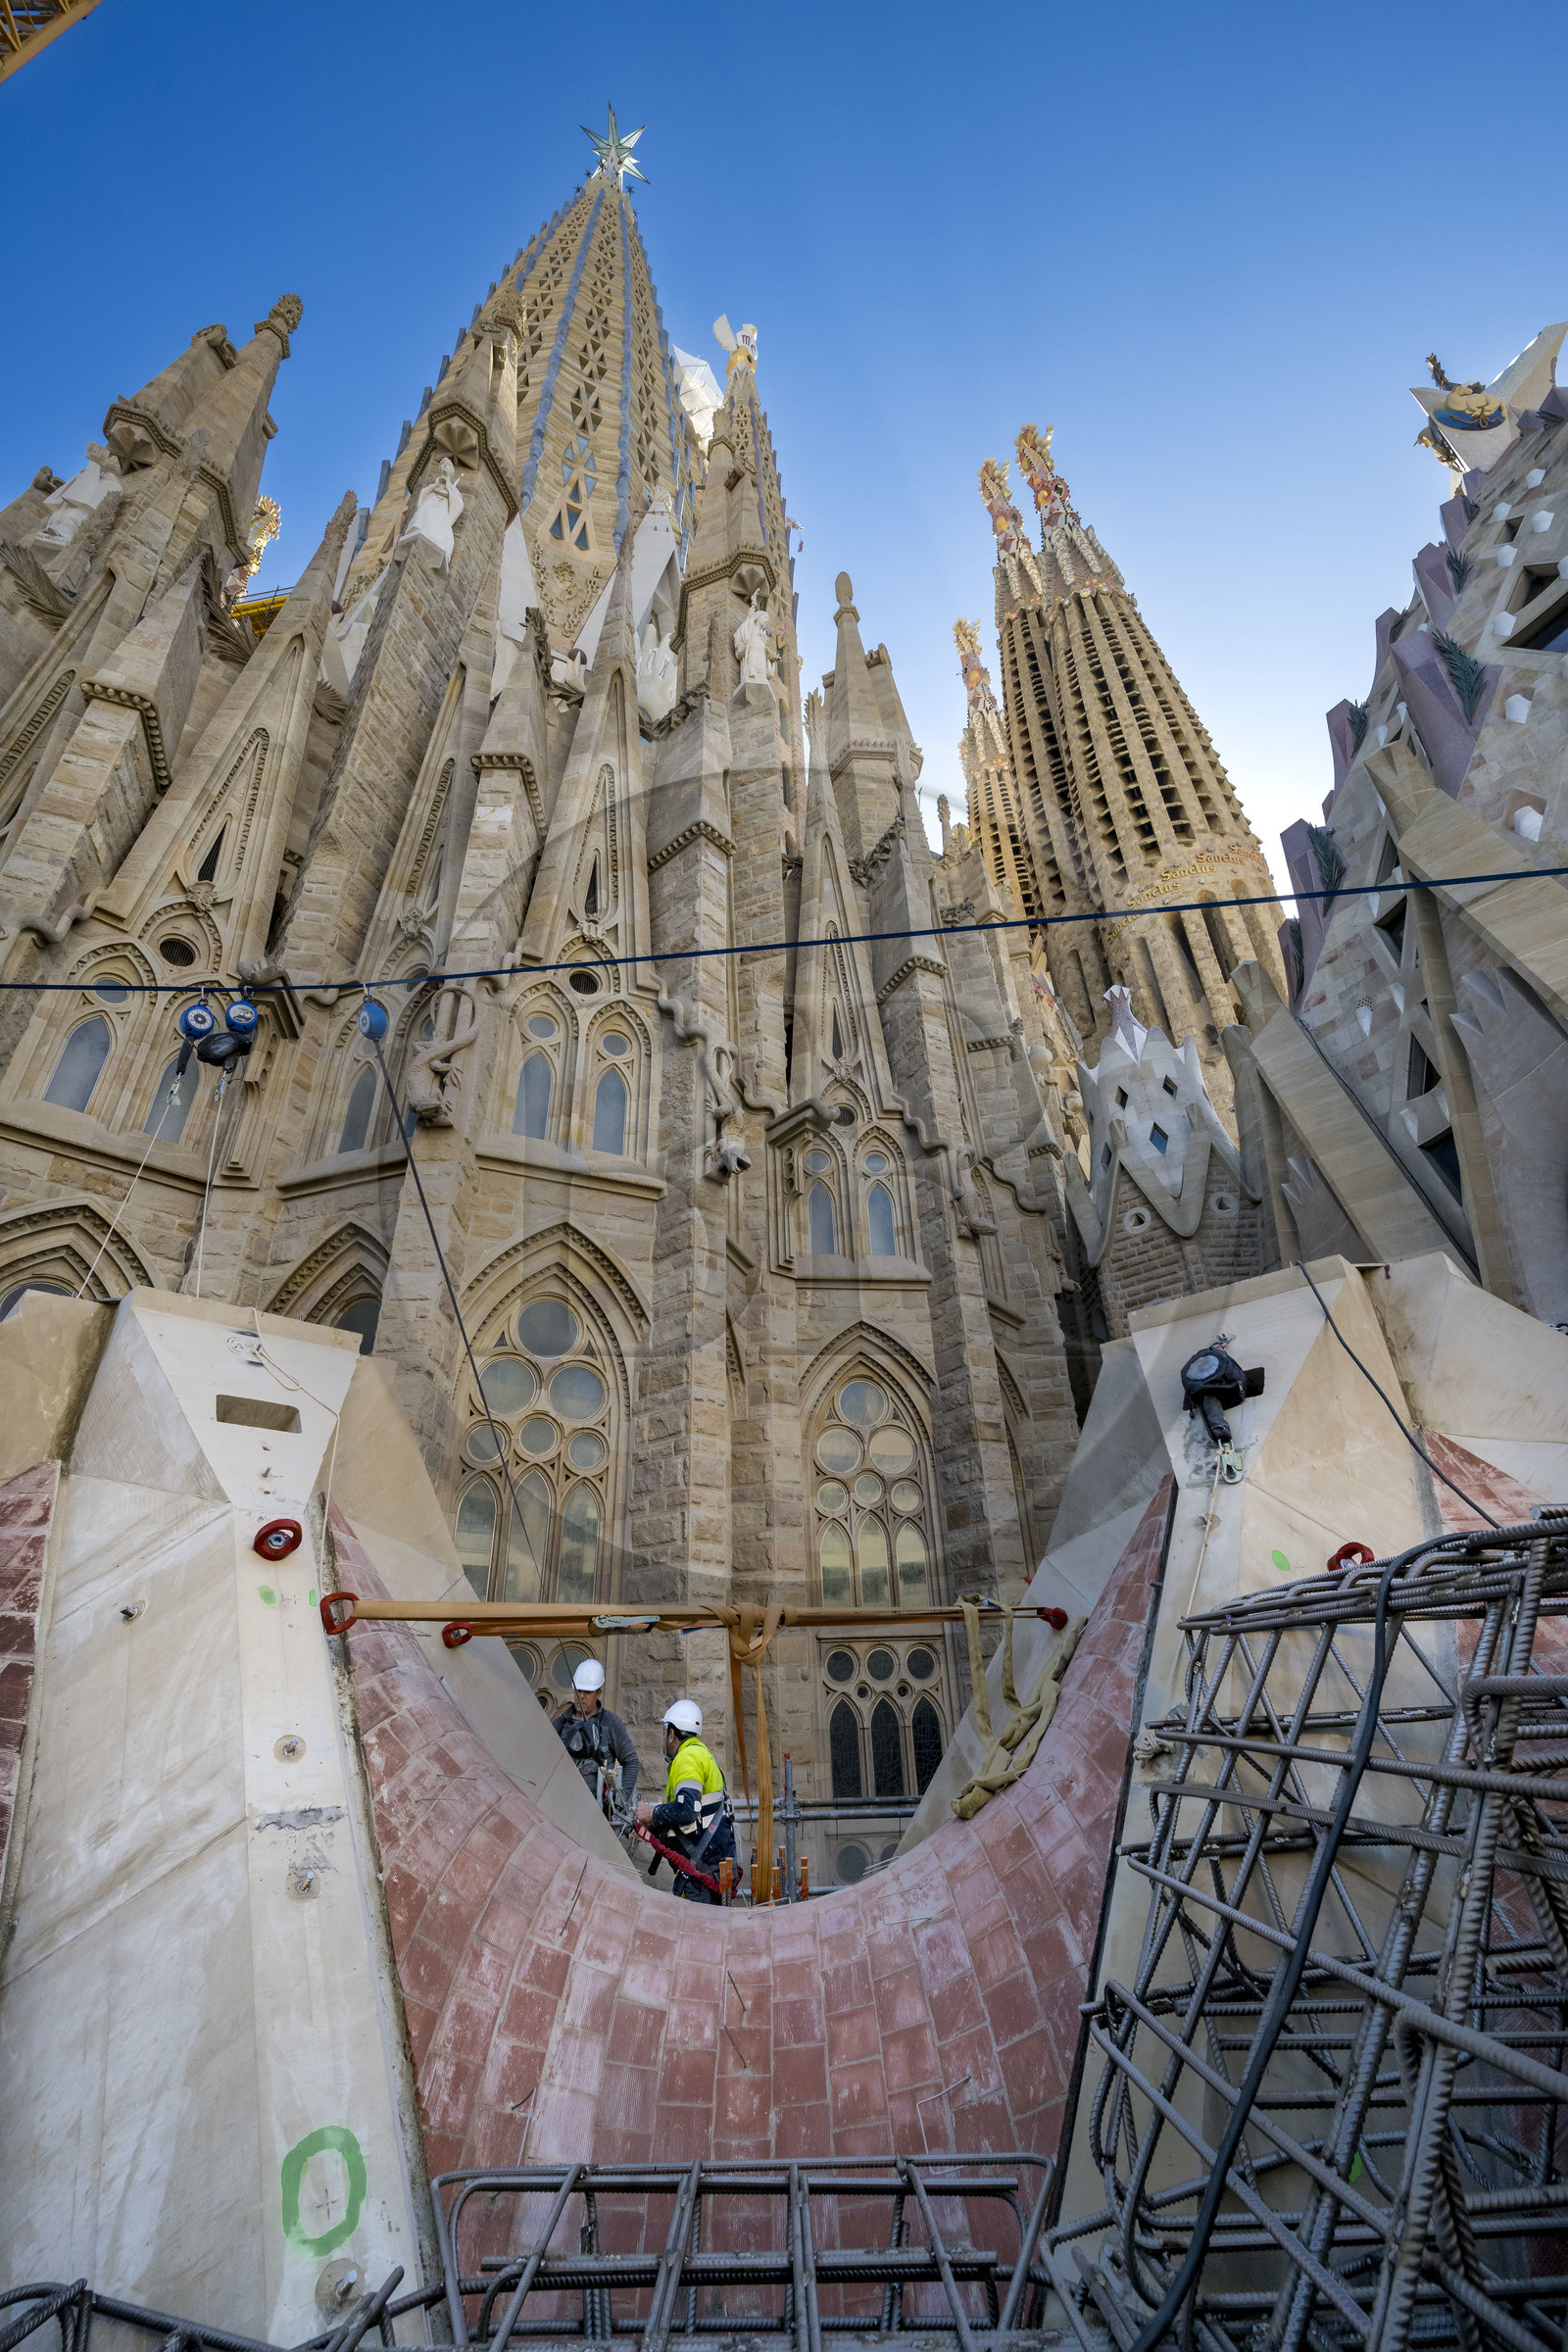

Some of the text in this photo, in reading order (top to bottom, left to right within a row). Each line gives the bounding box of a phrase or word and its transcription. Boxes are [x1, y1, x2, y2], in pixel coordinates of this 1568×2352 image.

[1196, 852, 1246, 866] Sanctus
[1160, 862, 1217, 882] Sanctus
[1127, 882, 1181, 910] Sanctus
[1105, 908, 1145, 944] Sanctu
